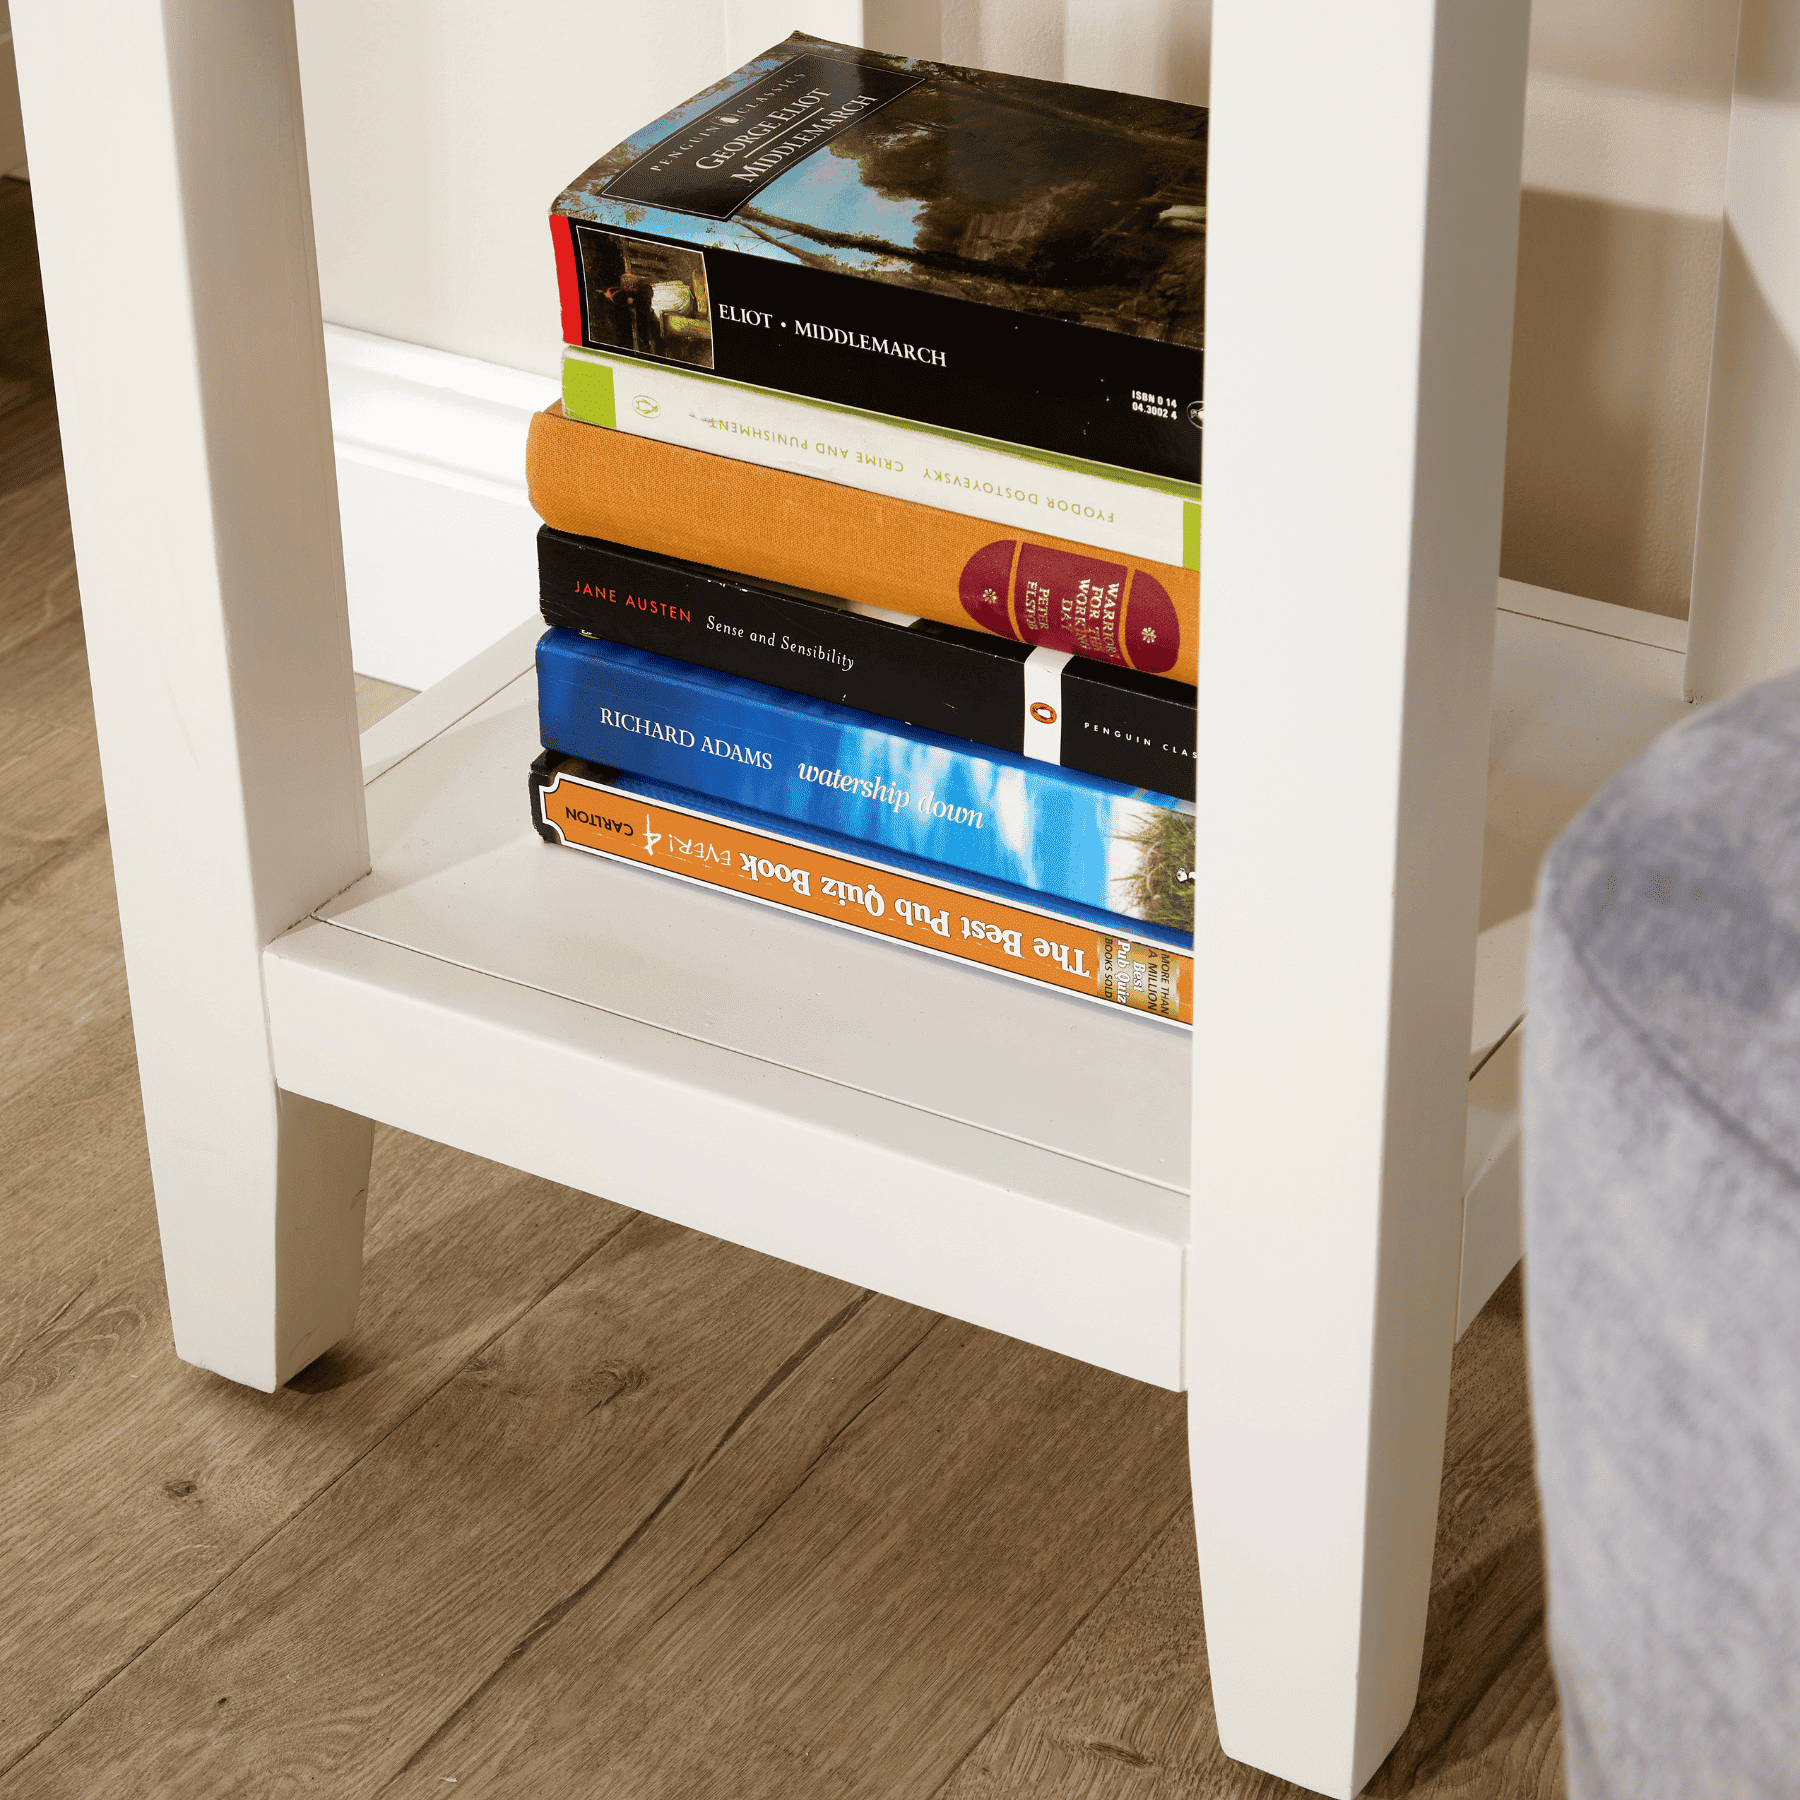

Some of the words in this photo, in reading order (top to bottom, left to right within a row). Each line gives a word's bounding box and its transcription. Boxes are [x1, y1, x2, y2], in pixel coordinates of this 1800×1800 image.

[651, 125, 721, 171] PENGUIN
[736, 72, 806, 114] CLASSICS
[695, 120, 781, 169] GEORGE
[766, 88, 831, 122] ELIOT
[730, 95, 878, 182] MIDDLEMARCH
[718, 303, 773, 328] ELIOT
[794, 319, 947, 368] MIDDLEMARCH
[1131, 389, 1155, 404] ISBN
[1157, 395, 1164, 406] 0
[1166, 397, 1178, 409] 14
[1131, 401, 1169, 419] 04.3002
[1170, 410, 1178, 420] 4
[709, 417, 808, 450] PUNISHMENT
[815, 442, 849, 459] AND
[856, 451, 904, 472] CRIME
[922, 467, 1039, 505] DOSTOYEVSKY
[1046, 496, 1115, 523] FYODOR
[1037, 587, 1050, 629] PETER
[1089, 586, 1104, 619] FOR
[574, 580, 617, 603] JANE
[625, 594, 692, 623] AUSTEN
[705, 615, 744, 638] Sense
[749, 628, 776, 647] and
[780, 635, 854, 672] Sensibility
[1084, 721, 1151, 747] PENGUIN
[600, 707, 696, 748] RICHARD
[701, 735, 773, 770] ADAMS
[797, 762, 911, 812] watership
[917, 791, 984, 829] down
[566, 806, 634, 837] CARLTON
[642, 814, 662, 855] 4
[669, 833, 732, 866] EVER!
[738, 852, 812, 896] Book
[820, 876, 885, 917] Quiz
[894, 898, 951, 938] Pub
[960, 916, 1025, 958] Best
[1148, 949, 1158, 958] A
[1033, 937, 1091, 978] The
[1104, 938, 1113, 971] BOOKS
[1117, 940, 1131, 968] Pub
[1160, 953, 1170, 984] MORE
[1104, 974, 1113, 998] SOLD
[1114, 971, 1130, 1004] Quiz
[1132, 960, 1146, 992] Best
[1147, 962, 1158, 1011] MILLION
[1160, 987, 1170, 1015] THAN
